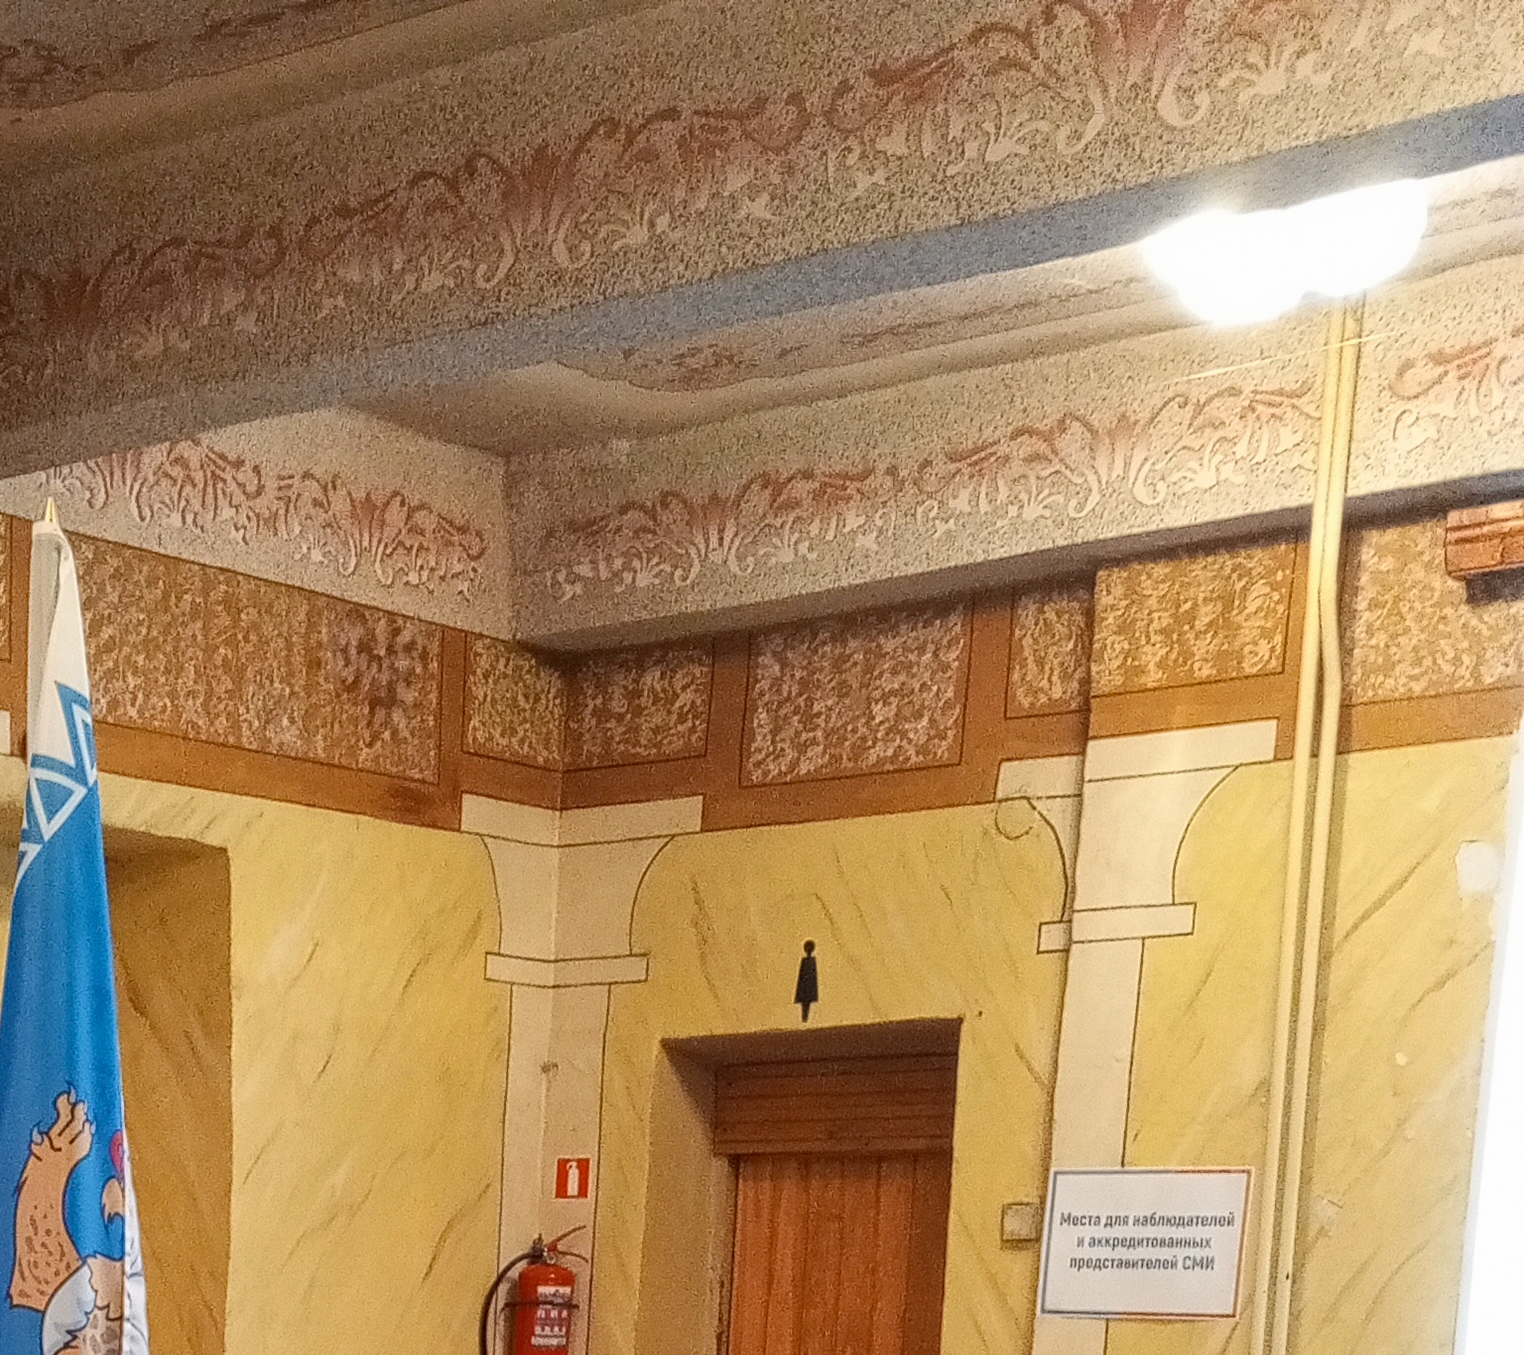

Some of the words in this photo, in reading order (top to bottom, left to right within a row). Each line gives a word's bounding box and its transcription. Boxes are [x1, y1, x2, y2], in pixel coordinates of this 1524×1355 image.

[1059, 1212, 1101, 1227] Места
[1103, 1214, 1129, 1229] для
[1132, 1211, 1236, 1229] наблюдателей
[1077, 1236, 1085, 1248] и
[1088, 1236, 1212, 1251] аккредитованных
[1069, 1254, 1178, 1272] представителей
[1182, 1255, 1215, 1271] СМИ
